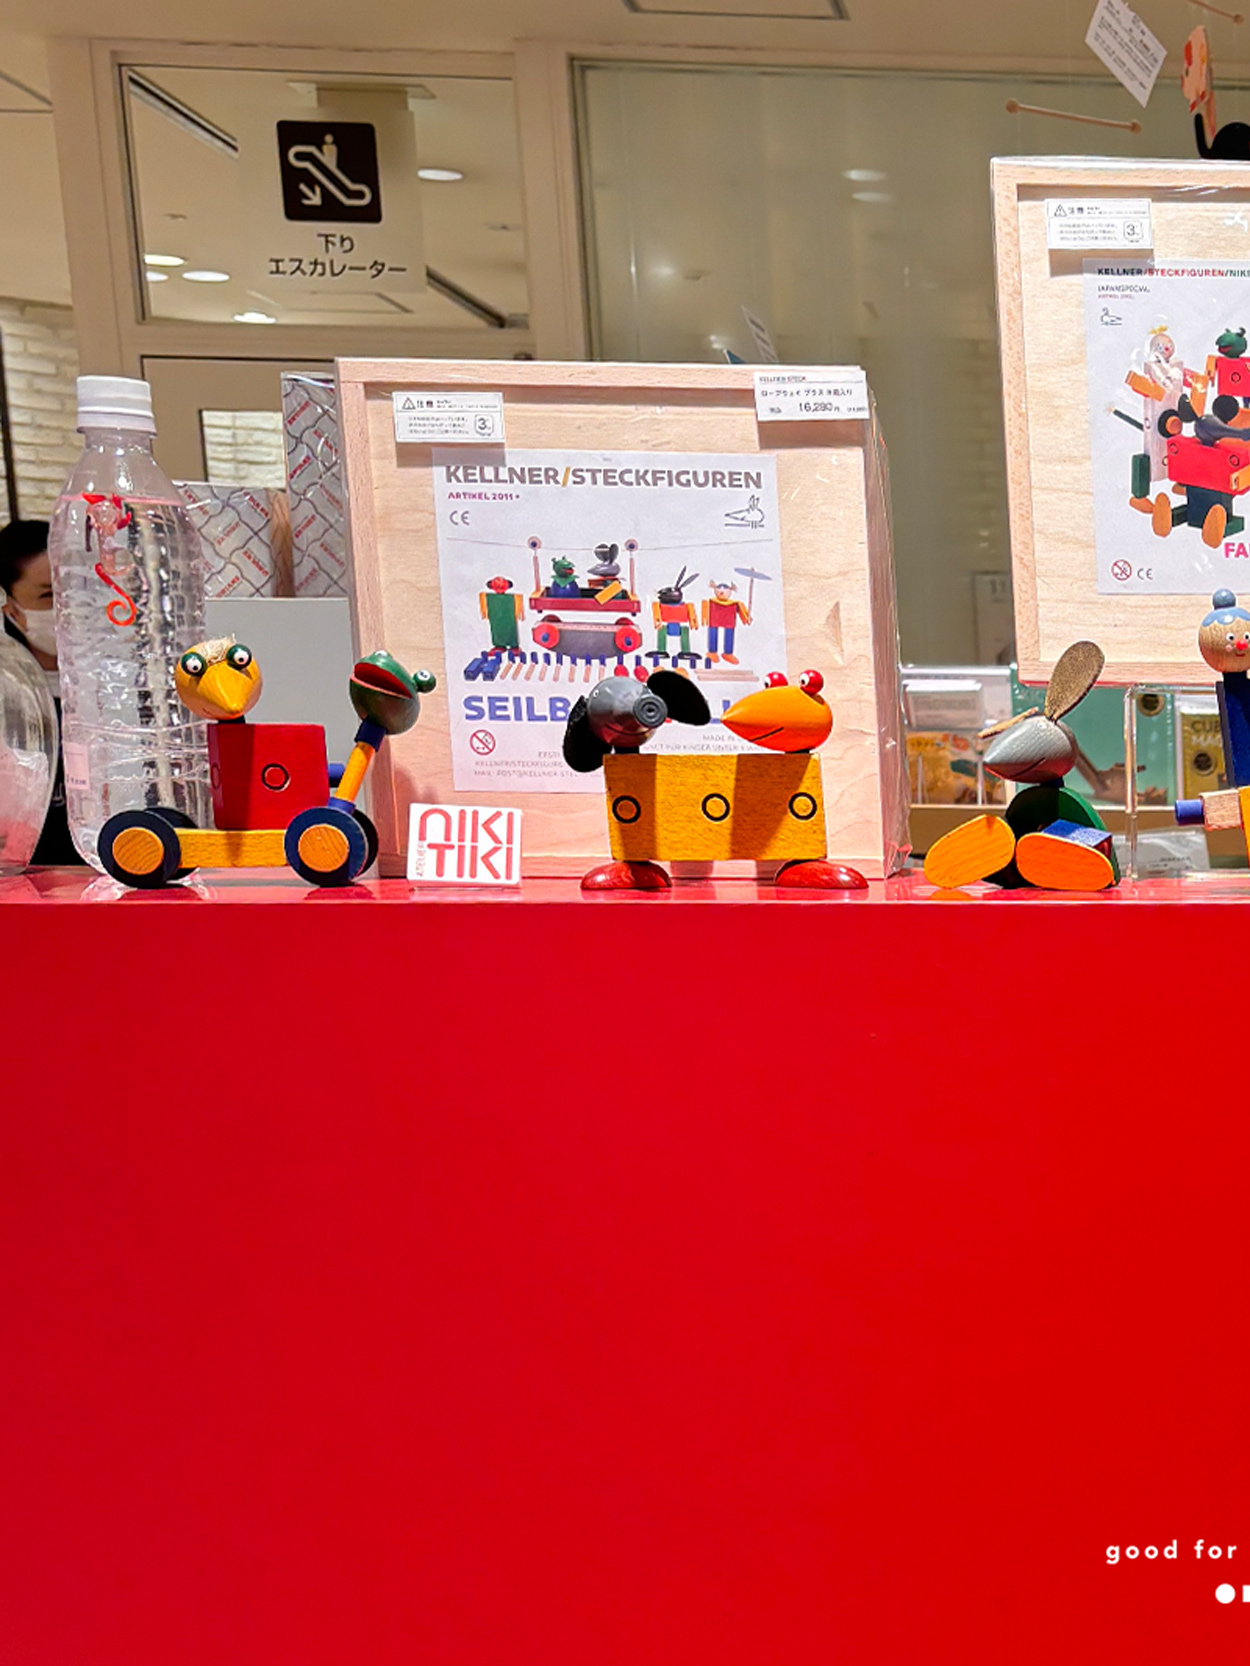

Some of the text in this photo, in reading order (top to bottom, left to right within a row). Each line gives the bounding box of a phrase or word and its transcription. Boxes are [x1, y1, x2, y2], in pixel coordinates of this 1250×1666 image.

[317, 233, 355, 254] 下り
[269, 258, 407, 279] エスカレーター
[445, 465, 763, 489] KELLNER/STECKFIGUREN
[447, 492, 490, 500] ARTIKEL
[463, 694, 571, 723] SEILB
[418, 807, 514, 845] NIKI
[427, 843, 514, 881] TIKI
